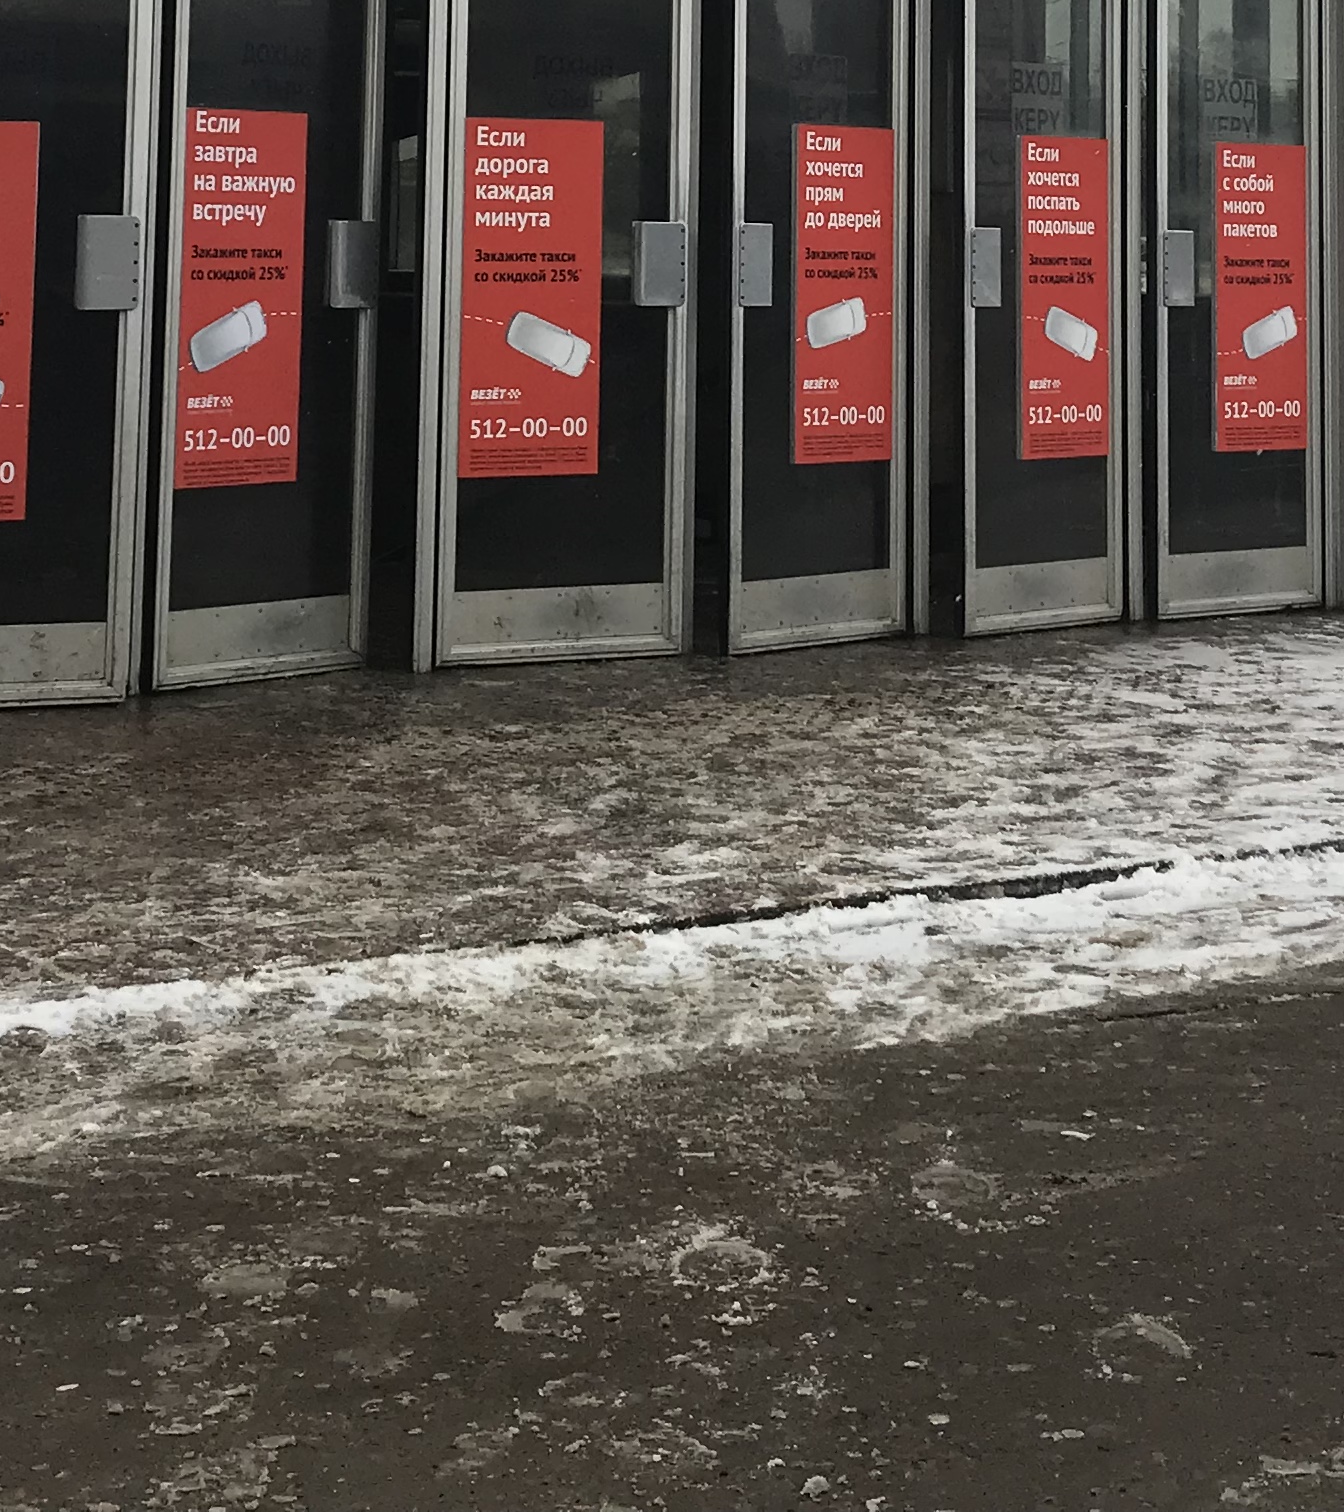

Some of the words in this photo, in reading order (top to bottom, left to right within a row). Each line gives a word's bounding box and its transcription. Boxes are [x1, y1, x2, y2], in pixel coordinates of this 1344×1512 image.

[1203, 79, 1256, 108] ВХОД
[196, 111, 240, 133] Если
[477, 126, 525, 146] Если
[807, 132, 841, 151] Если
[195, 146, 256, 168] завтра
[1028, 143, 1059, 161] Если
[1224, 150, 1255, 168] Если
[475, 158, 548, 178] дорога
[806, 161, 863, 177] хочется
[194, 175, 215, 190] на
[222, 176, 295, 198] важную
[1028, 172, 1079, 186] хочется
[1223, 178, 1230, 192] с
[1233, 174, 1274, 193] собой
[476, 185, 553, 203] каждая
[806, 187, 843, 205] прям
[1028, 196, 1080, 210] поспать
[193, 204, 266, 226] встречу
[1224, 201, 1264, 214] много
[476, 212, 550, 232] минута
[805, 212, 824, 228] до
[828, 210, 880, 232] дверей
[1028, 220, 1094, 236] подольше
[1224, 224, 1277, 237] пакетов
[191, 245, 248, 258] Закажите
[251, 248, 282, 258] такси
[475, 249, 537, 262] Закажите
[540, 253, 575, 262] такси
[191, 269, 204, 280] со
[207, 267, 256, 281] скидкой
[475, 272, 488, 282] со
[493, 270, 546, 283] скидкой
